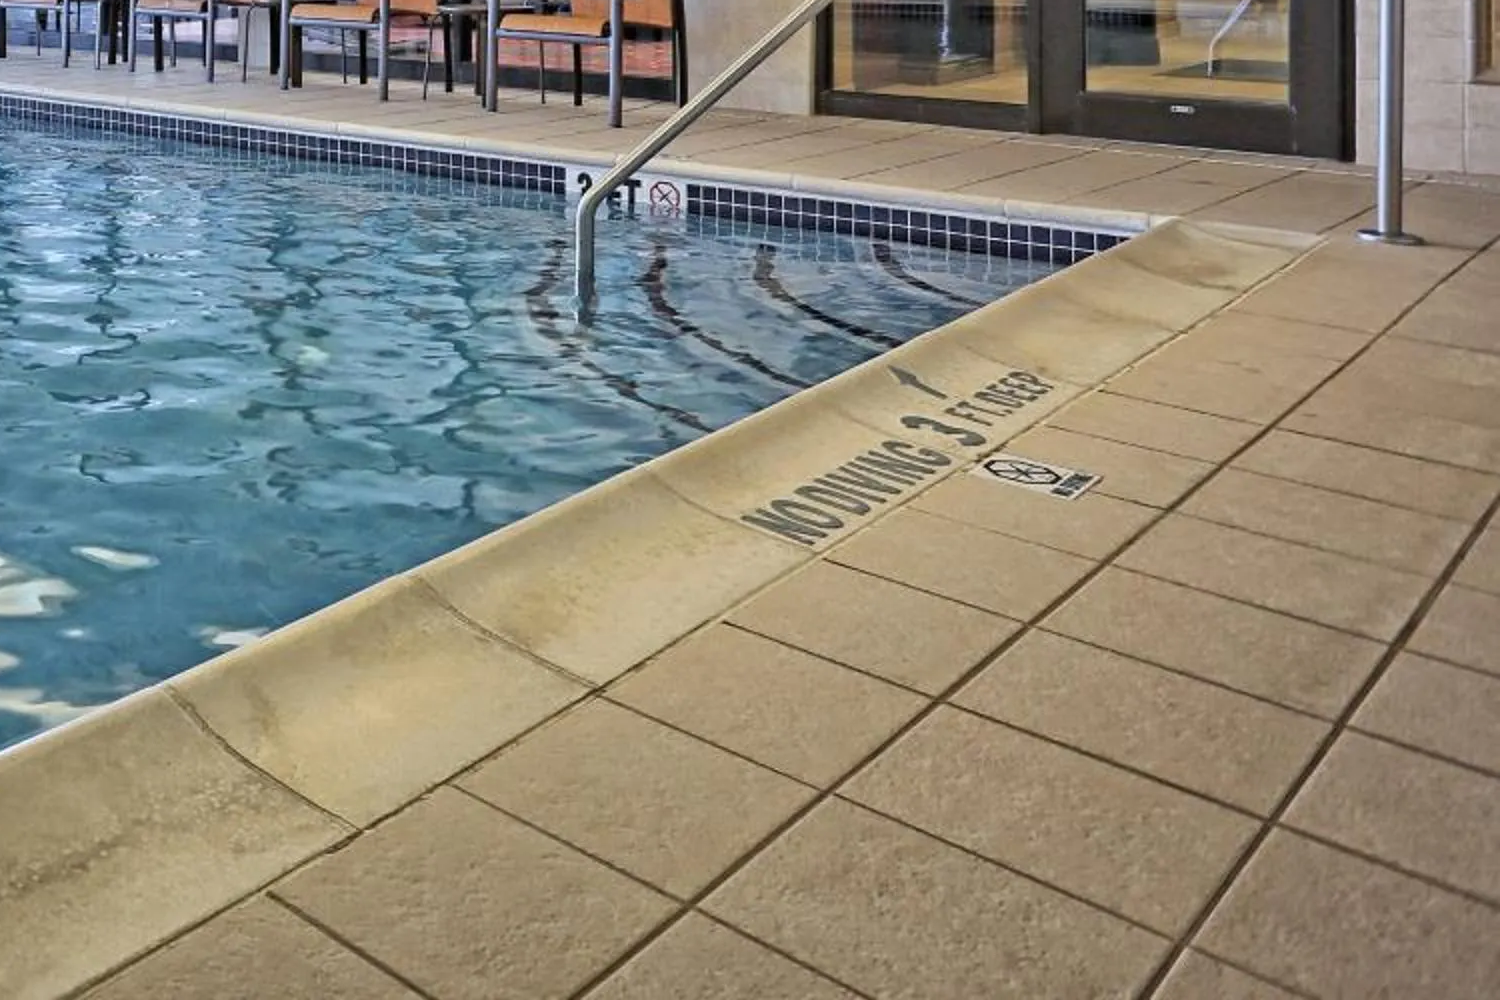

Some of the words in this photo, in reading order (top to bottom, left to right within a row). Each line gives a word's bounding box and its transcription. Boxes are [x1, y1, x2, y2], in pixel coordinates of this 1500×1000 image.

[740, 498, 845, 547] NO
[794, 439, 953, 517] DIVING
[900, 415, 987, 448] 3
